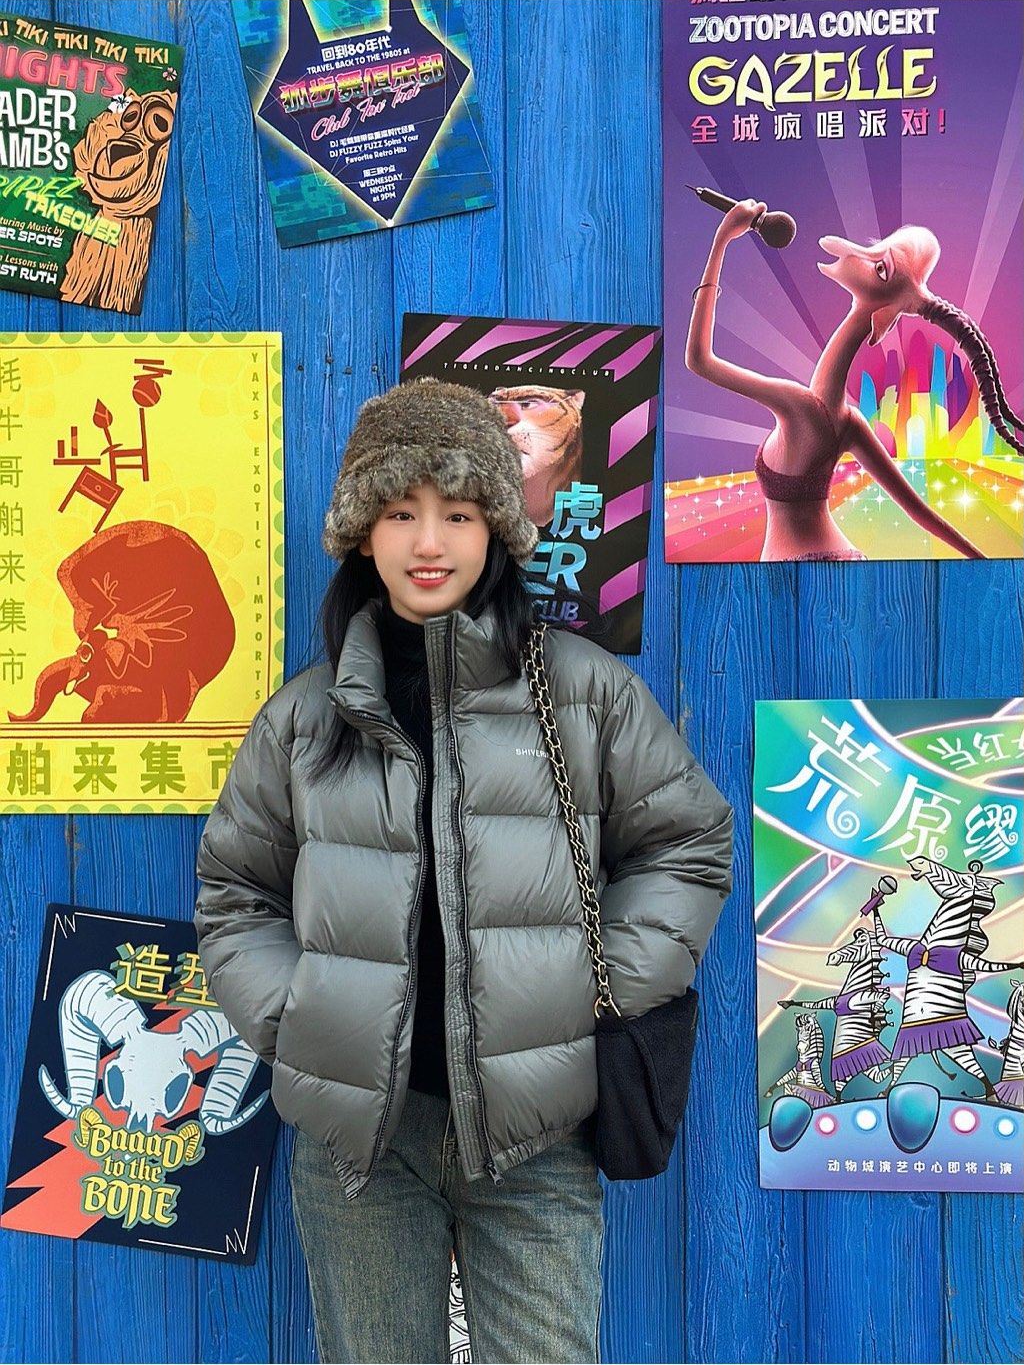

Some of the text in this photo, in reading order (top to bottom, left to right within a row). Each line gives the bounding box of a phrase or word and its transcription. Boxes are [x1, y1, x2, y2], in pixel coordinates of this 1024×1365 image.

[689, 6, 940, 43] ZOOTOPIA CONCERT
[16, 19, 48, 45] TIKI
[54, 32, 88, 50] TIKI
[94, 37, 128, 63] TIKI
[134, 47, 169, 64] TIKI
[321, 35, 392, 62] 回到80年代
[307, 63, 334, 75] TRAVEL
[335, 60, 355, 71] BACK
[356, 57, 365, 65] TO
[366, 53, 380, 63] THE
[403, 47, 411, 55] at
[279, 53, 446, 113] 狐步舞俱乐部
[688, 44, 938, 112] GAZELLE
[311, 83, 420, 141] Club Fox Trot
[690, 107, 946, 144] 全城疯唱派对!
[329, 140, 339, 148] DJ
[329, 135, 419, 158] DJ FUZZY FUZZ Spins Your
[345, 146, 407, 164] Favorite Retro Hits
[358, 173, 403, 188] WEDNESDAY
[369, 183, 395, 194] NIGHTS
[380, 191, 396, 200] 9PM
[24, 190, 122, 247] TAKEOVER
[27, 221, 52, 233] Music
[53, 225, 65, 238] by
[18, 230, 64, 248] SPOTS
[5, 254, 37, 268] Lessons
[39, 260, 59, 271] with
[20, 267, 57, 285] RUTH
[549, 481, 603, 540] 虎
[250, 352, 264, 701] YAXS EXOTIC IMPORTS
[103, 1155, 162, 1183] to the
[827, 1159, 1013, 1175] 动物城演艺中心即将上演
